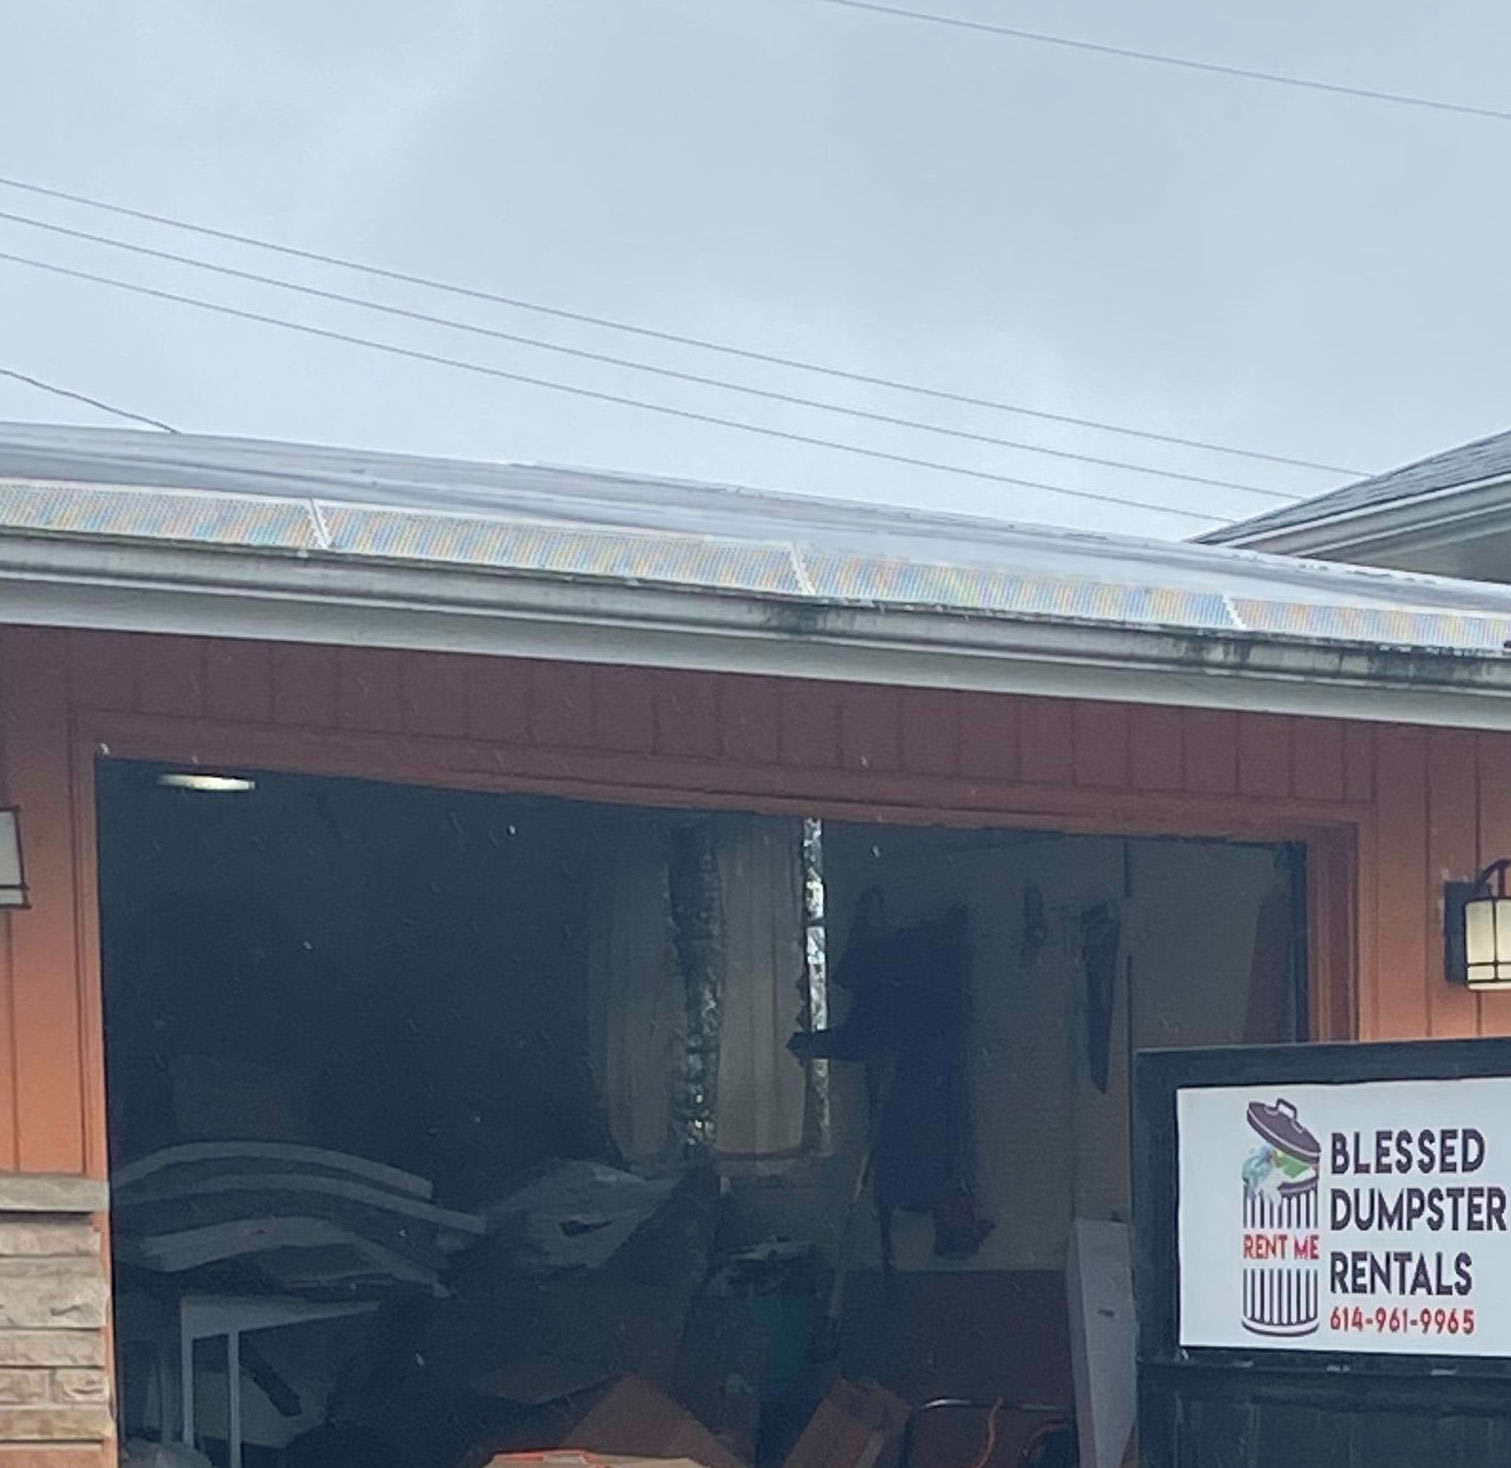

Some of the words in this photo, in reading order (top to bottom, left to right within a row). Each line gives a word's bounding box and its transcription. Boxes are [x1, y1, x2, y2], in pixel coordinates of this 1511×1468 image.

[1331, 1129, 1485, 1175] BLESSED
[1330, 1187, 1507, 1232] DUMPSTER
[1243, 1233, 1288, 1260] RENT
[1293, 1233, 1320, 1260] ME
[1330, 1251, 1473, 1296] RENTALS
[1330, 1307, 1475, 1336] 614-961-9965
